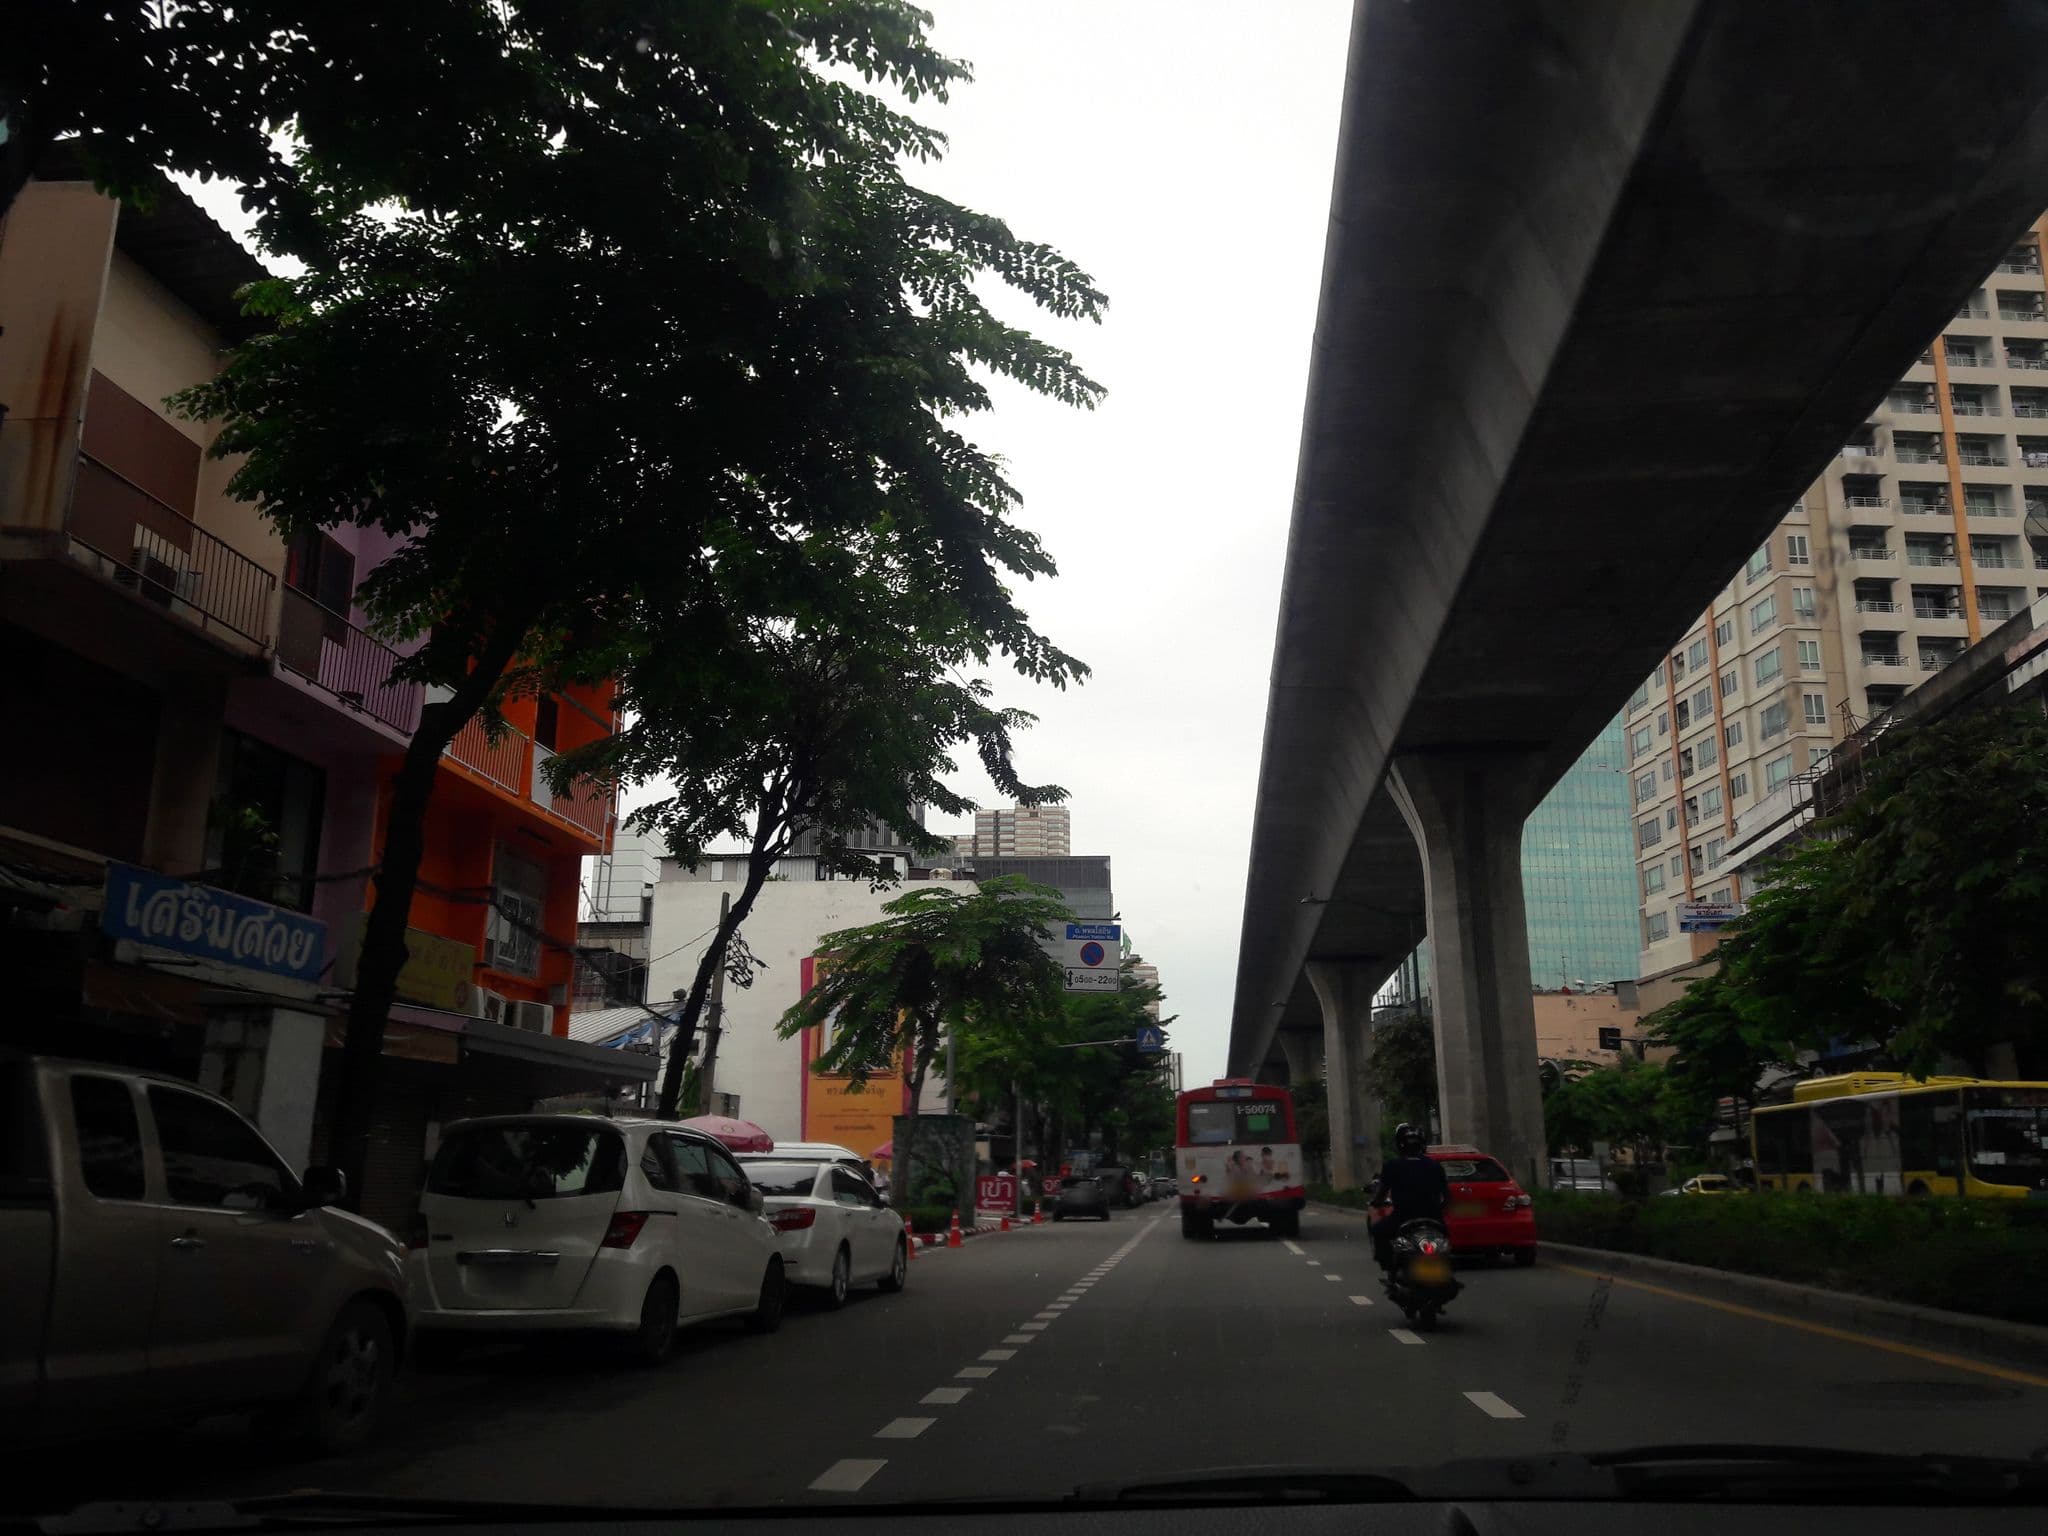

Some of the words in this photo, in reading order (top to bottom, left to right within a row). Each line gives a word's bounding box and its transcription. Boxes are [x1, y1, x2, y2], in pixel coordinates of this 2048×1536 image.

[125, 881, 315, 970] เสริมสวย
[981, 1176, 1012, 1198] เข้า
